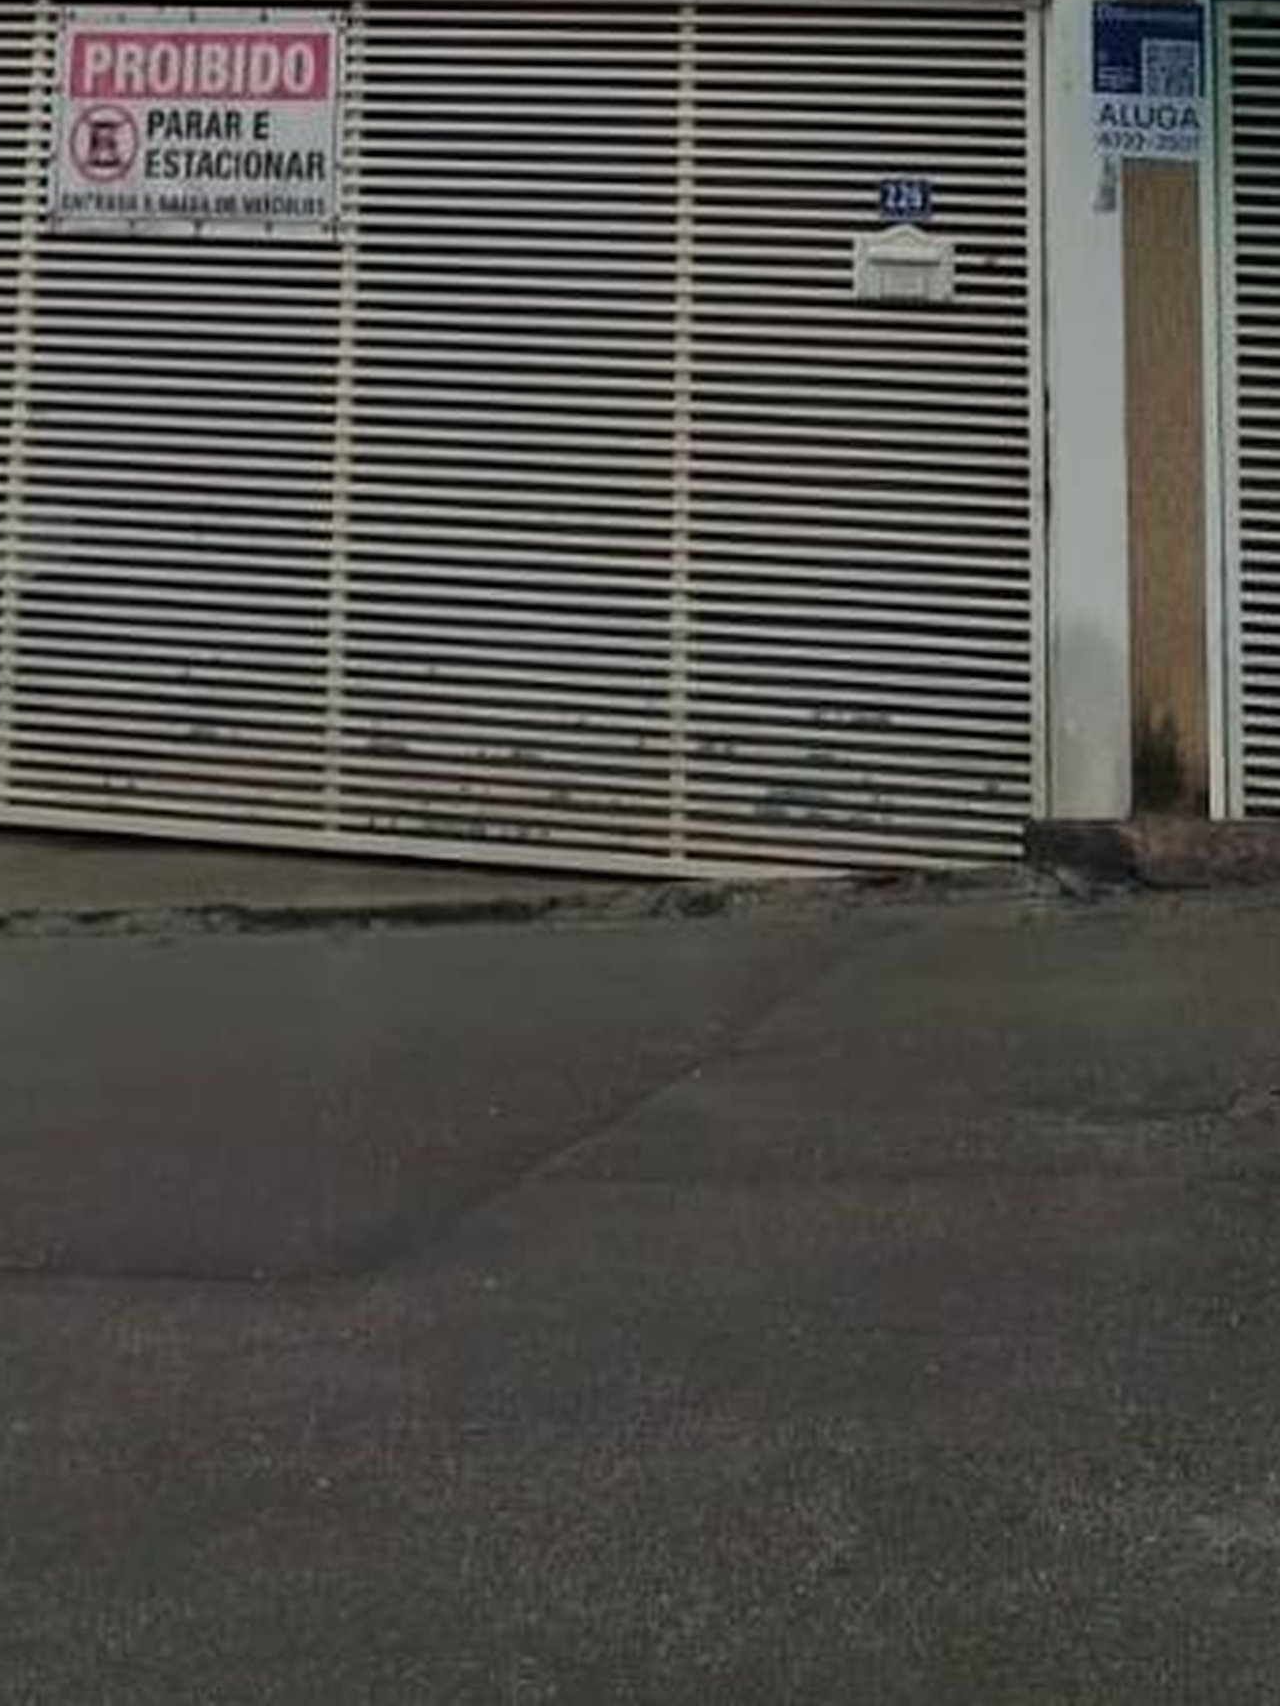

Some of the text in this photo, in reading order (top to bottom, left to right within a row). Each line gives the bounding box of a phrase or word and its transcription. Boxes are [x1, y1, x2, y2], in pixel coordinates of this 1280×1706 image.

[83, 42, 316, 94] PROIBIDO
[147, 109, 271, 141] PARAR E
[1099, 103, 1200, 130] ALUGA
[144, 149, 326, 183] ESTACIONAR
